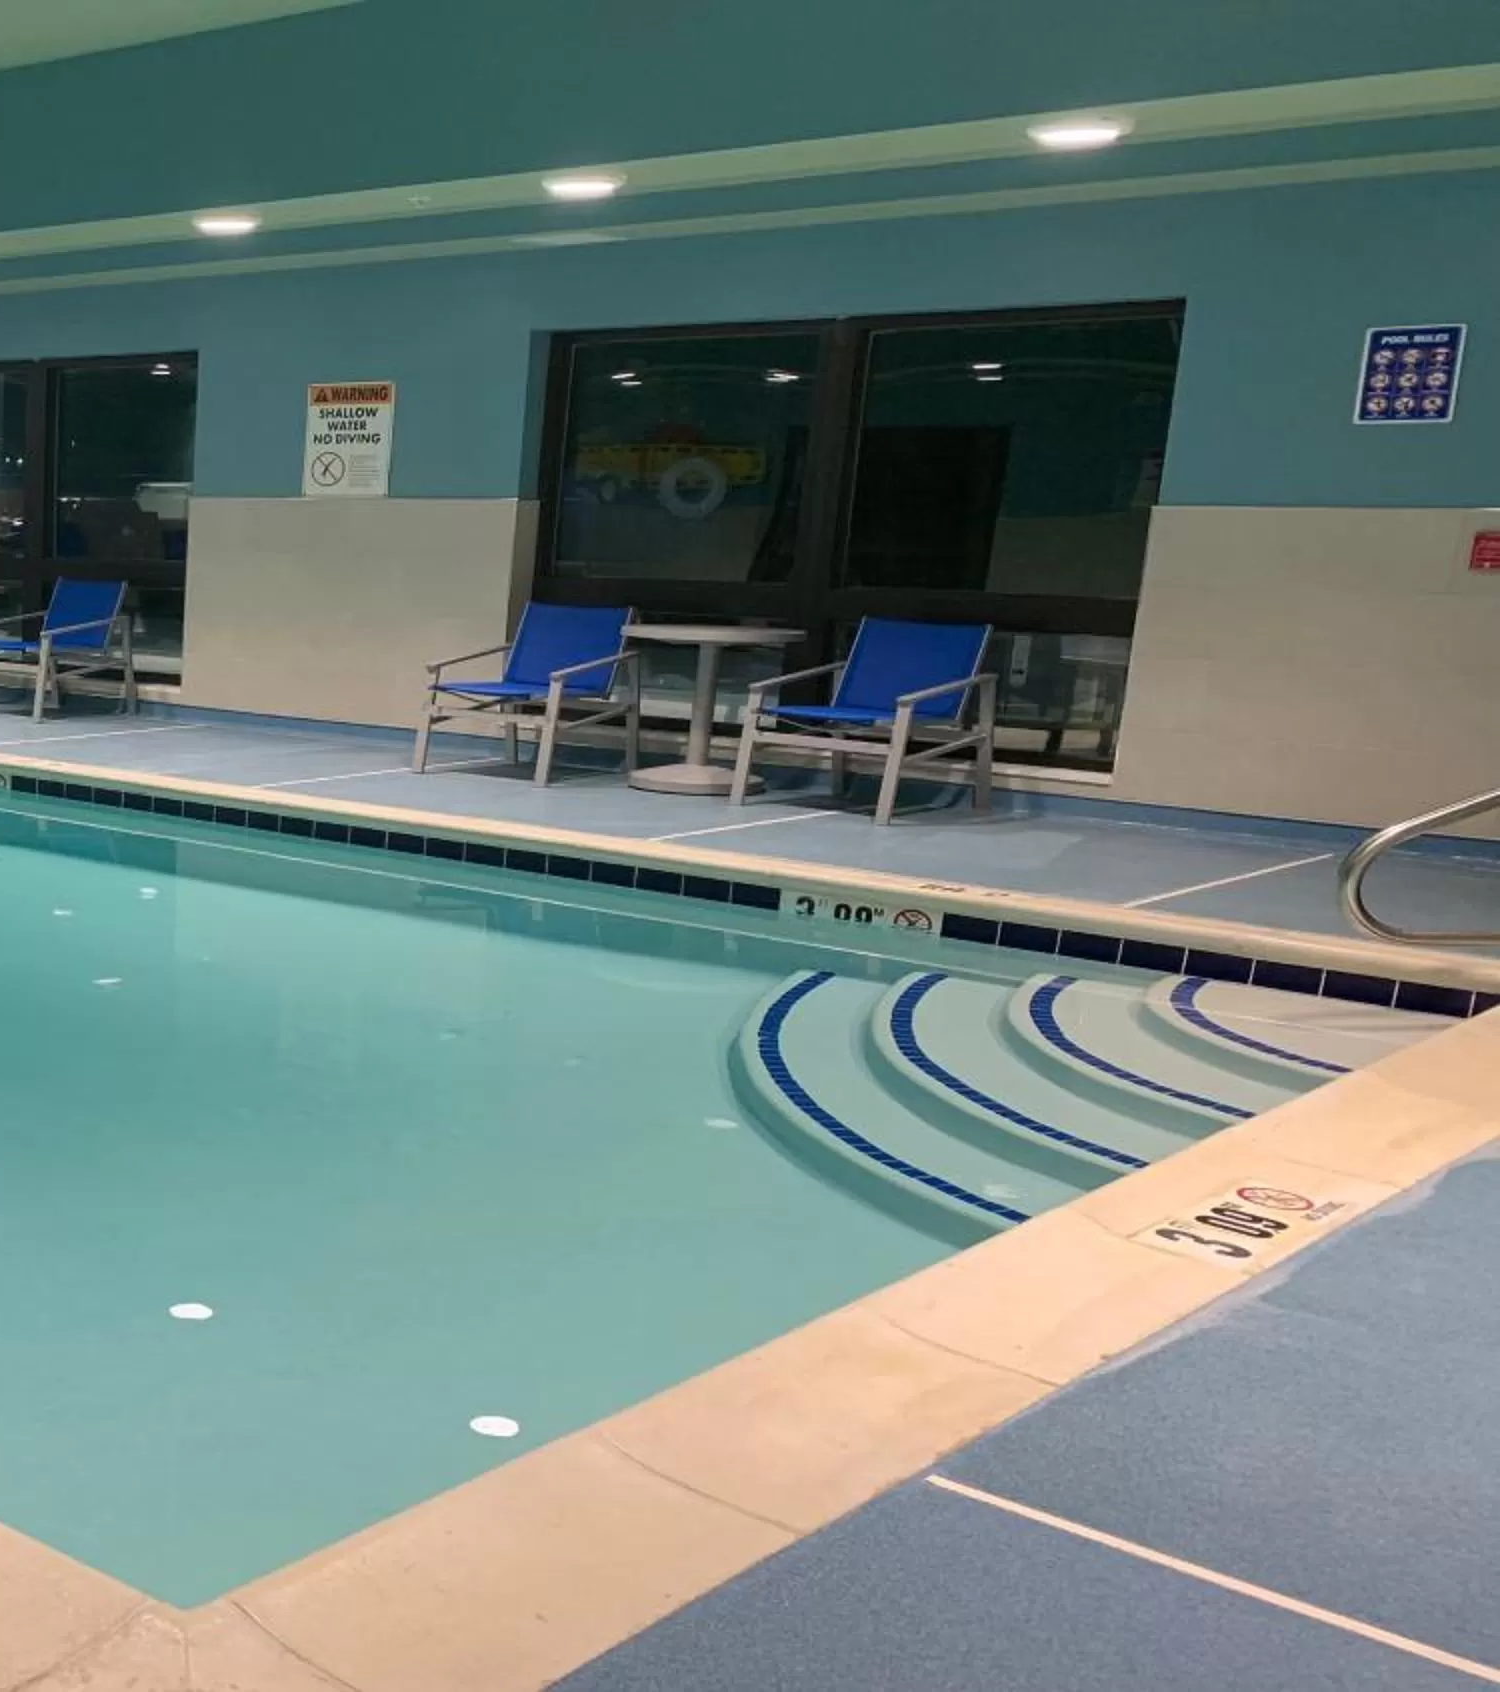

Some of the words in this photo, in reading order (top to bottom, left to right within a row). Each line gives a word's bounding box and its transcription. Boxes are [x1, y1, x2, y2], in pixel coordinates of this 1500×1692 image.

[1381, 335, 1409, 344] POOL
[332, 386, 388, 401] WARNING
[319, 407, 378, 418] SHALLOW
[328, 420, 367, 431] WATER
[313, 434, 332, 445] NO
[336, 433, 381, 445] DIVING
[1195, 1206, 1289, 1239] 09
[1155, 1228, 1252, 1258] 3
